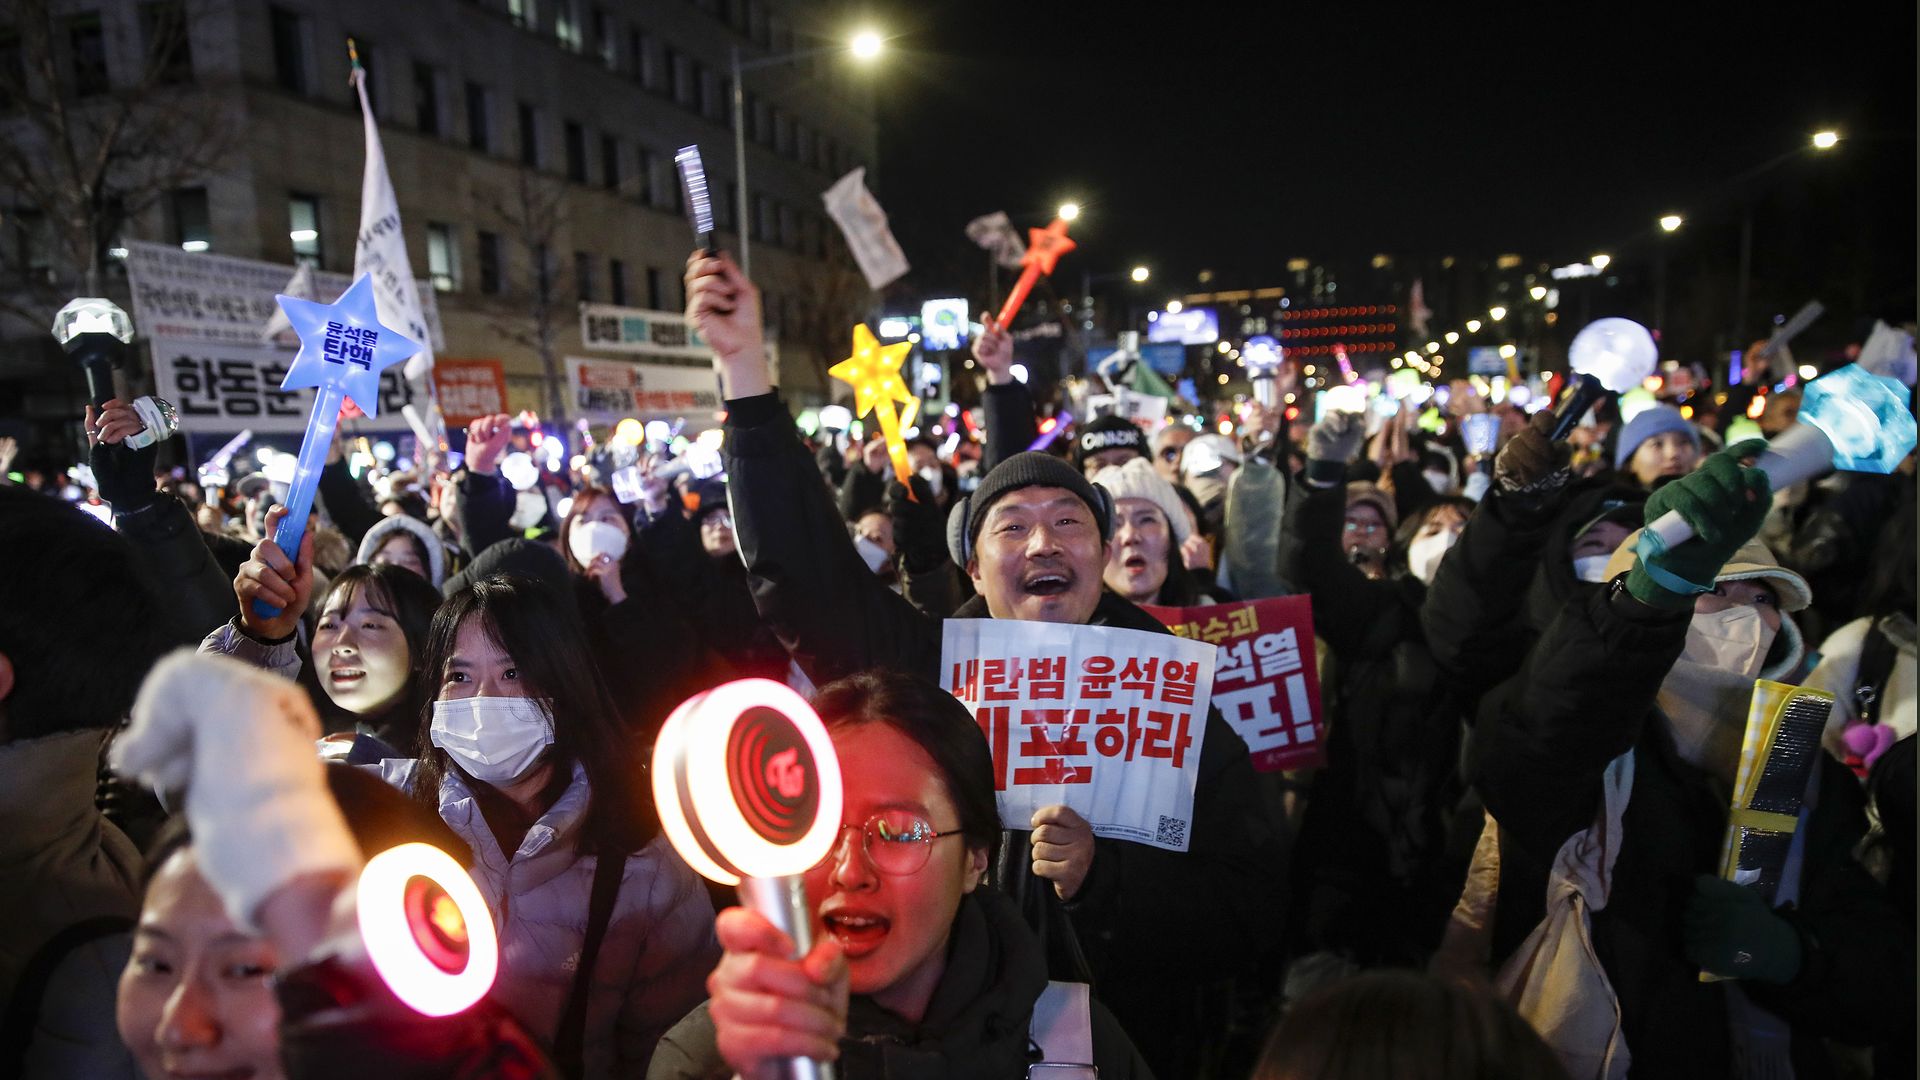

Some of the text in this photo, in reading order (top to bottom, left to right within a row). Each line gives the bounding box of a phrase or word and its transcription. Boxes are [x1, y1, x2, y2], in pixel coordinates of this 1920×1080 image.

[323, 338, 374, 371] 탄핵
[326, 321, 379, 348] 윤석열
[172, 354, 304, 417] 한동훈
[1167, 605, 1260, 644] 란수괴
[1216, 626, 1303, 683] 석열
[951, 655, 1200, 706] 내란범 윤석열
[1211, 672, 1317, 754] 포!
